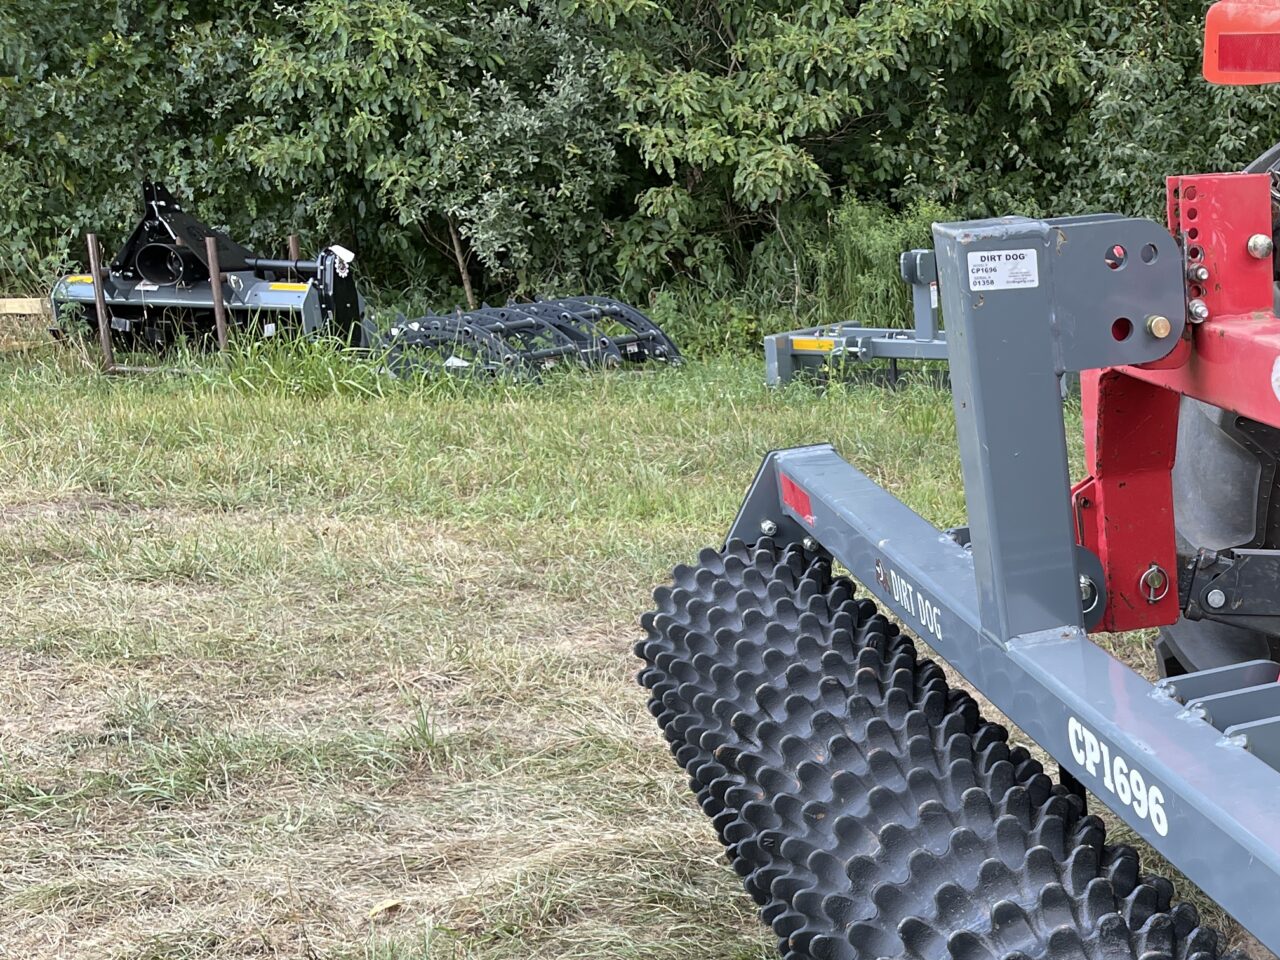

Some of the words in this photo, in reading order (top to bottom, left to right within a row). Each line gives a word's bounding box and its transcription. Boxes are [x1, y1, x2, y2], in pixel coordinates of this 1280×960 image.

[980, 254, 1002, 262] DIRT
[1005, 253, 1025, 261] DOG
[890, 569, 915, 617] DIRT
[916, 591, 943, 641] DOG
[1067, 716, 1168, 837] CP1696
